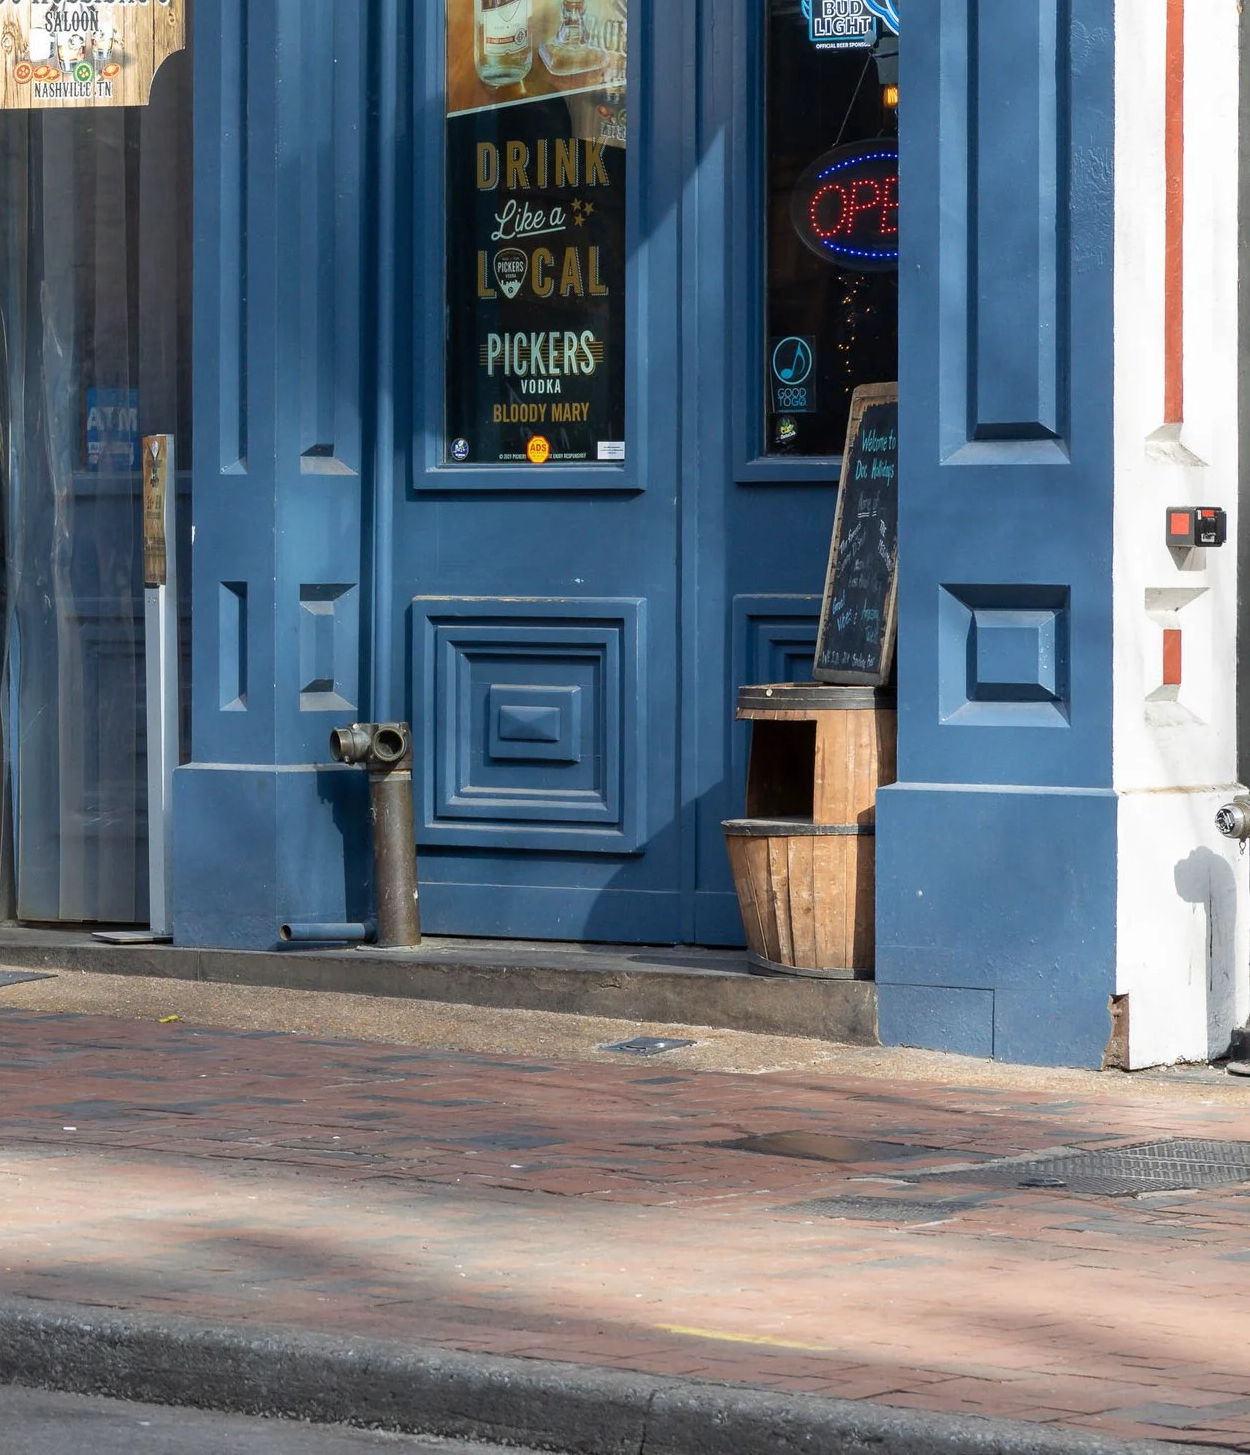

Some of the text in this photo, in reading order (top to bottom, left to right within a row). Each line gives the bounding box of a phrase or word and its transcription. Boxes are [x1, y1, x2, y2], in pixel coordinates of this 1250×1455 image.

[44, 10, 99, 33] SALOON
[814, 16, 872, 37] LIGHT
[476, 137, 609, 191] DRINK
[811, 177, 899, 236] OPE
[491, 199, 566, 241] Like a
[497, 260, 524, 273] PICKERS
[487, 329, 597, 377] PICKERS
[520, 379, 562, 394] VODKA
[777, 387, 807, 398] GOOD
[493, 402, 590, 424] BLOODY MARY
[529, 443, 547, 453] ADS
[861, 428, 897, 452] Welcome to
[855, 459, 869, 481] Doc
